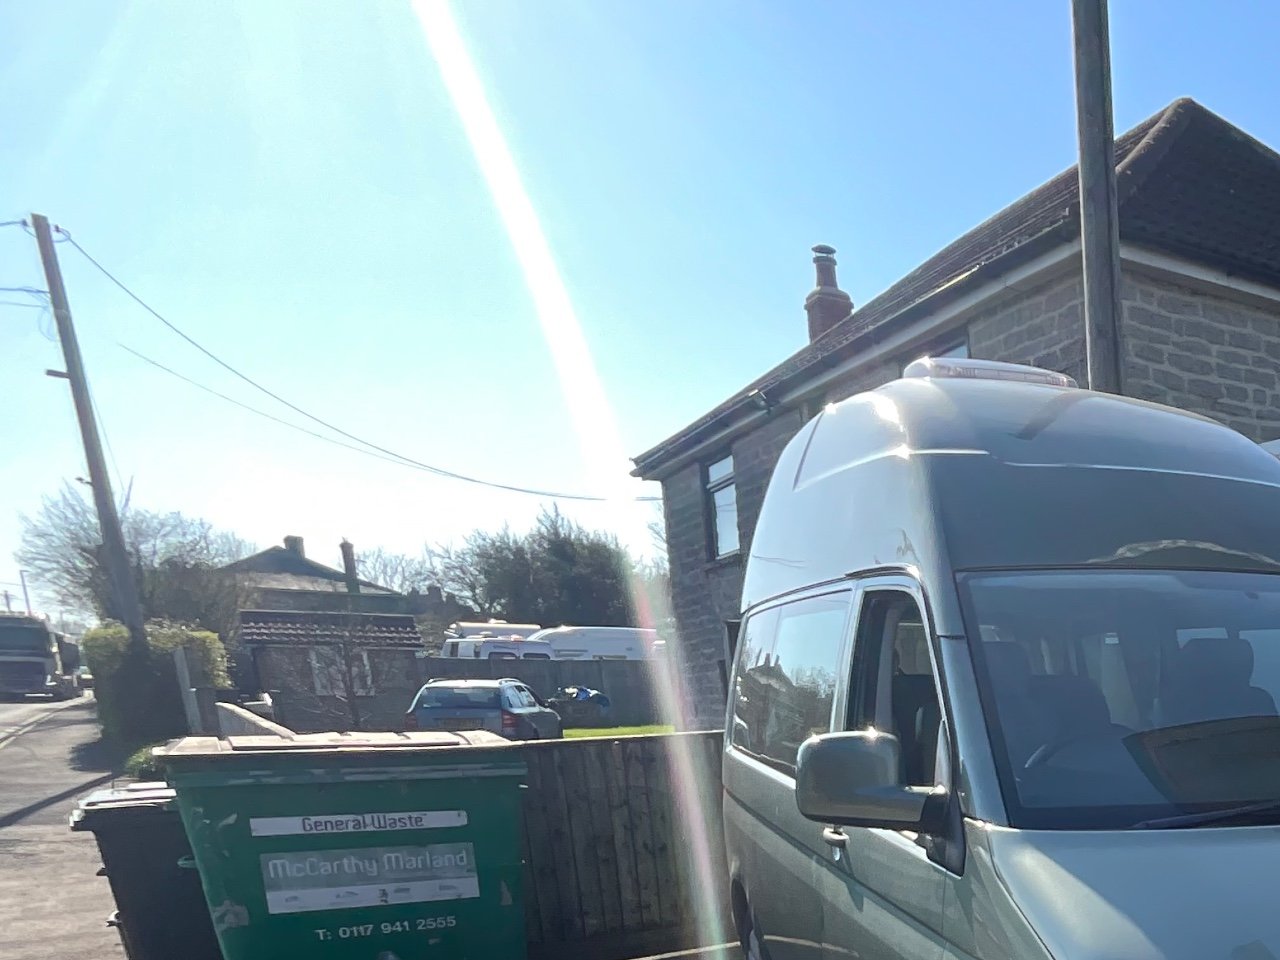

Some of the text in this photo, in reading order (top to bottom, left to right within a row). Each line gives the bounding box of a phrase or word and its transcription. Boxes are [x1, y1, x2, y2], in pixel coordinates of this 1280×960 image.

[301, 813, 424, 832] General Waste
[268, 849, 467, 879] McCarthy Marland
[315, 915, 456, 941] T: 0117 941 2555
